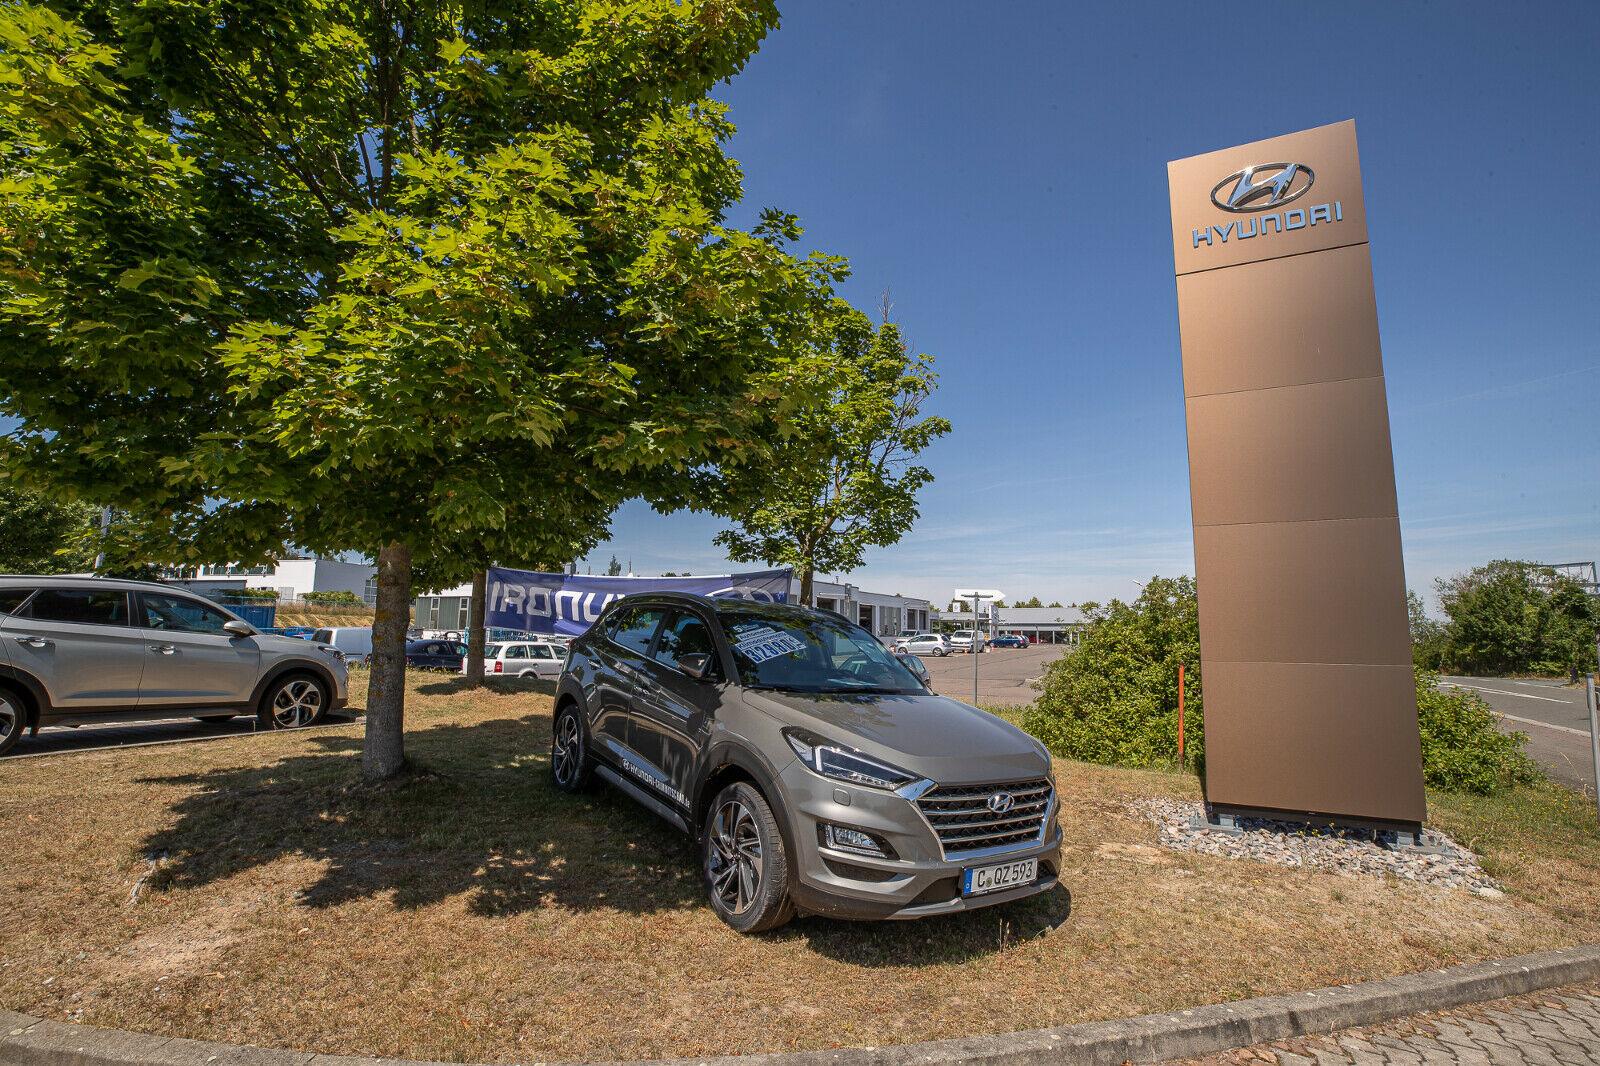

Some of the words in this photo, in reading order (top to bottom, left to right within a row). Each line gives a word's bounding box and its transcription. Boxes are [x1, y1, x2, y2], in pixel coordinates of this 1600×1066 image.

[1192, 201, 1342, 248] HYUNDAI
[977, 870, 986, 887] C
[994, 865, 1009, 884] QZ
[1011, 861, 1033, 880] 593
